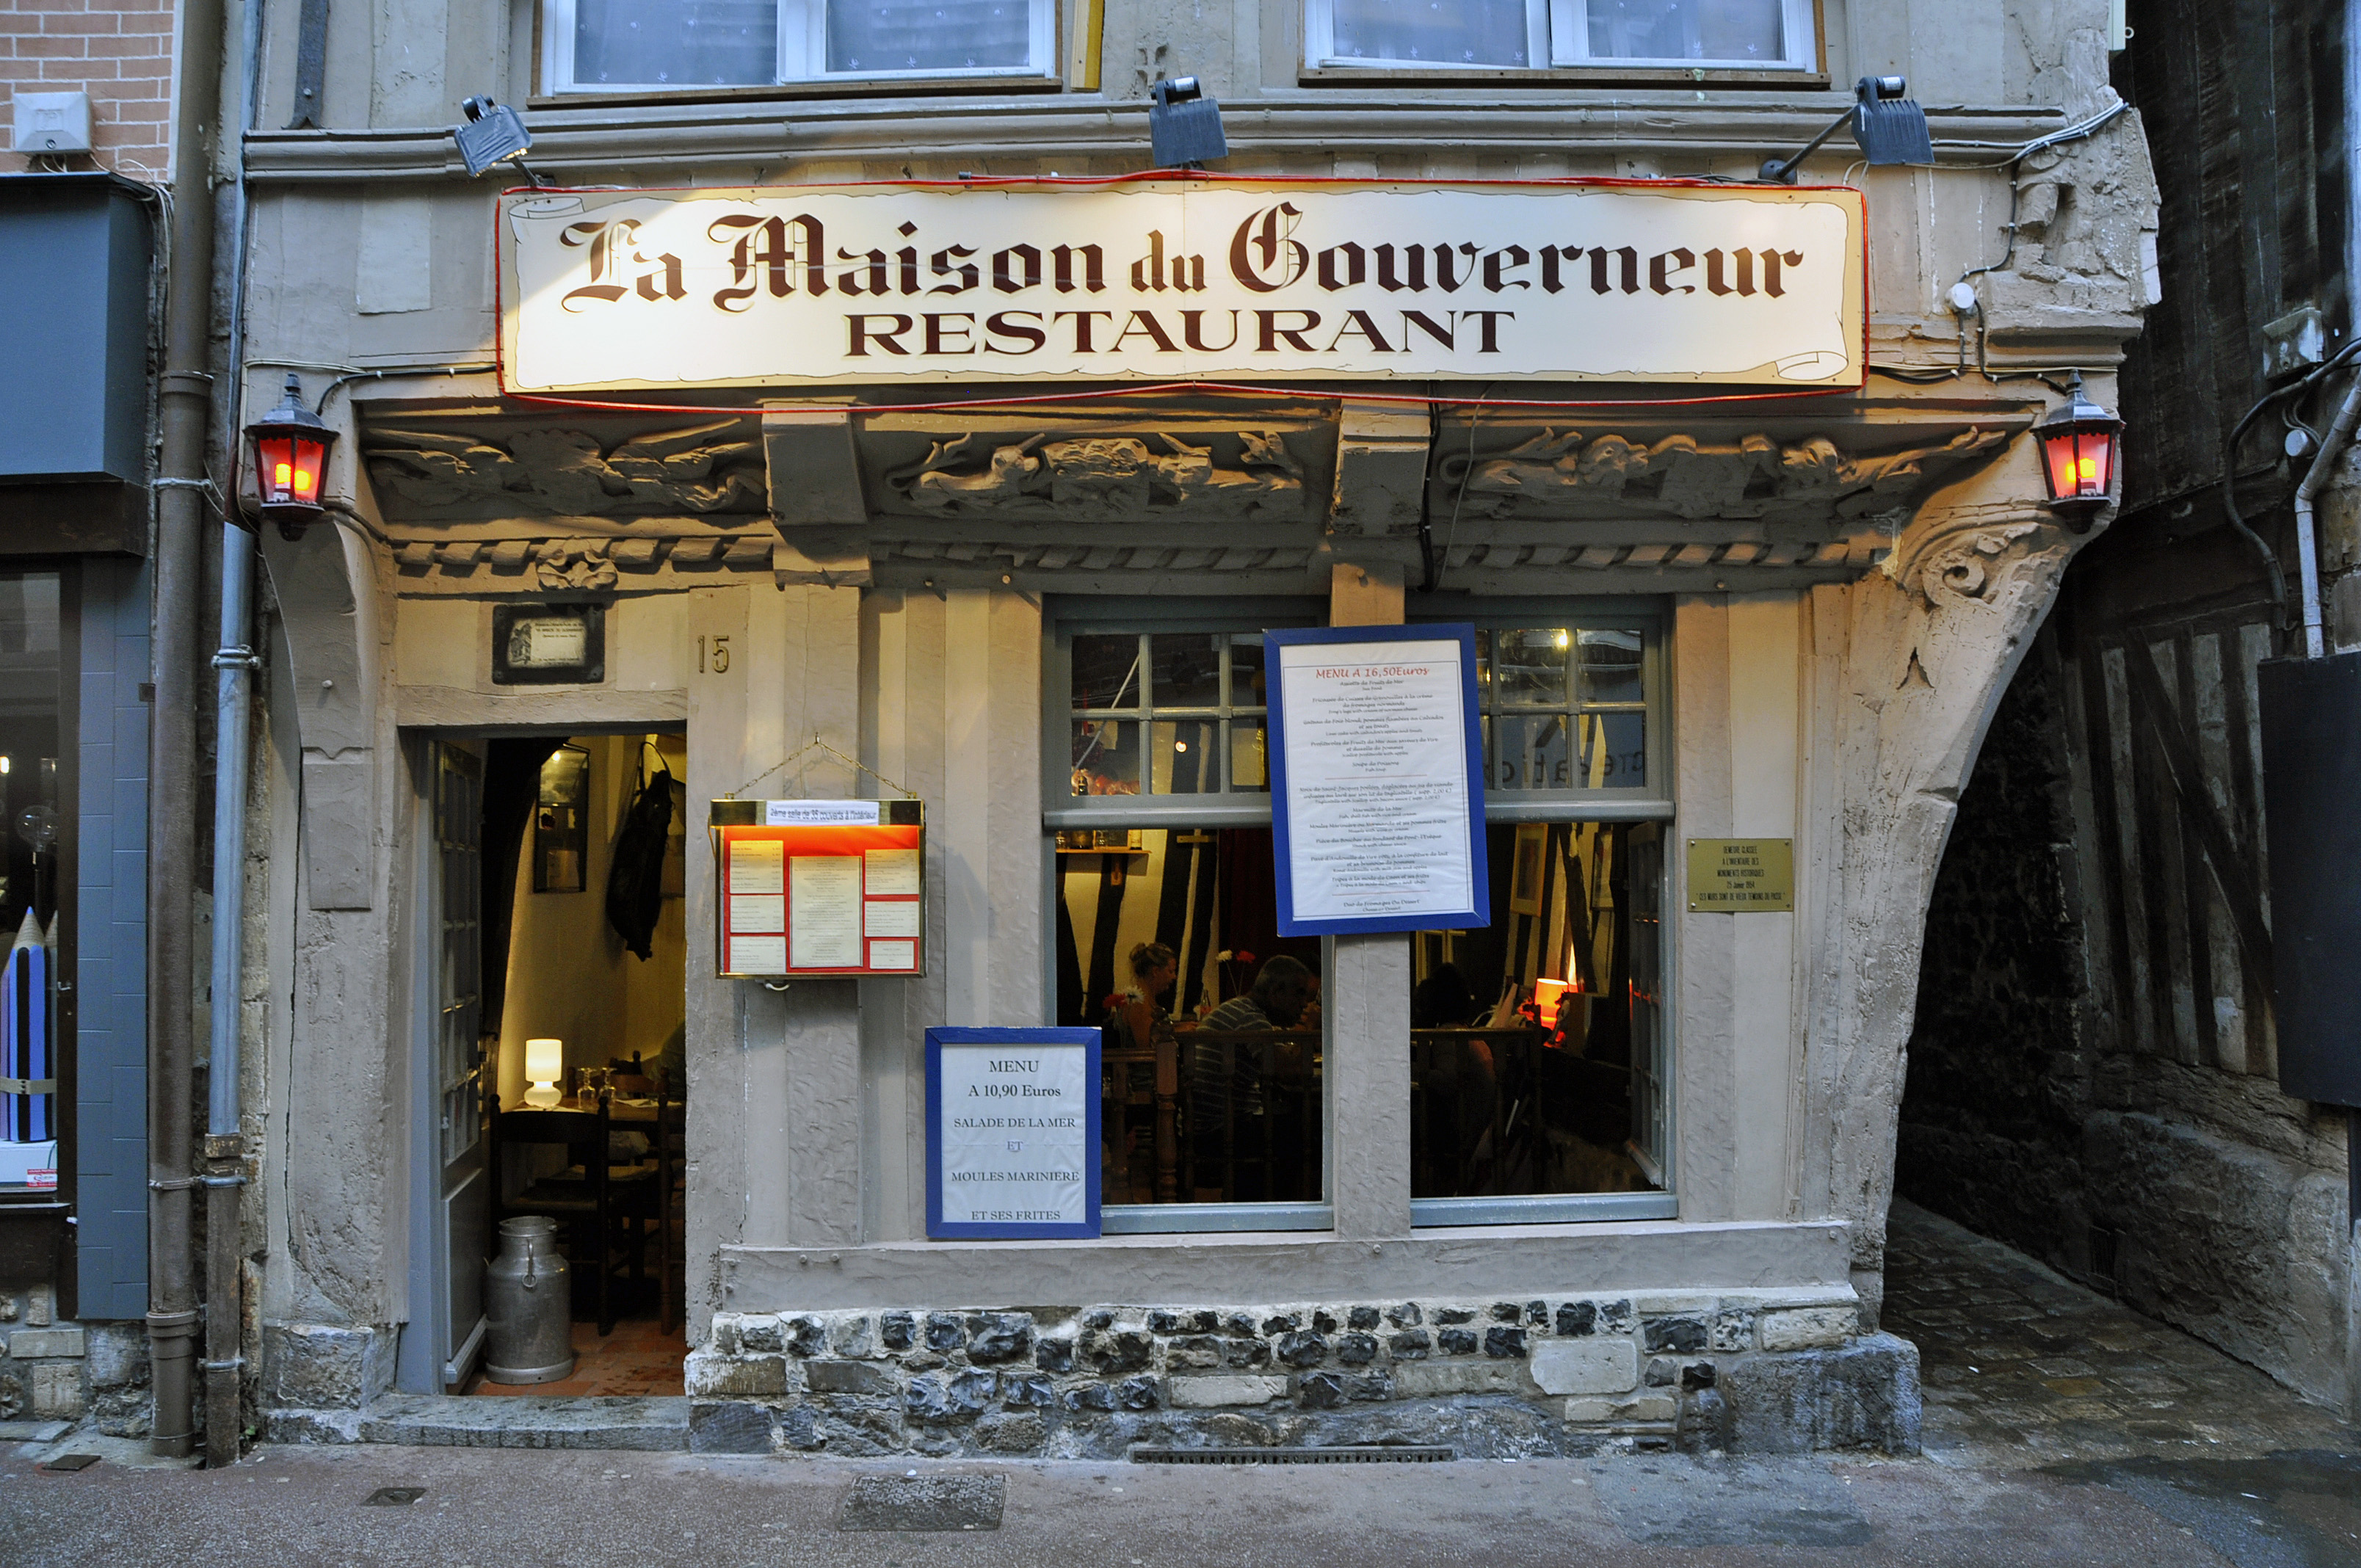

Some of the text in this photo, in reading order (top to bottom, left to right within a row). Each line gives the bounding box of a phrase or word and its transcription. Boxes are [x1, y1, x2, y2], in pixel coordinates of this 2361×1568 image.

[559, 201, 1804, 313] La Maison du Gouverneur
[843, 309, 1515, 357] RESTAURANT
[697, 635, 730, 673] 15
[1316, 668, 1349, 678] MENU
[1352, 668, 1360, 677] A
[802, 810, 810, 819] de
[845, 810, 849, 820] à
[990, 1061, 1039, 1073] MENU
[968, 1086, 1061, 1100] A 10,90 Euros
[954, 1118, 1076, 1128] SALADE DE LA MER
[1007, 1141, 1023, 1150] ET
[951, 1172, 1079, 1181] MOULES MARINIERE
[972, 1211, 1060, 1220] ET SES FRITES
